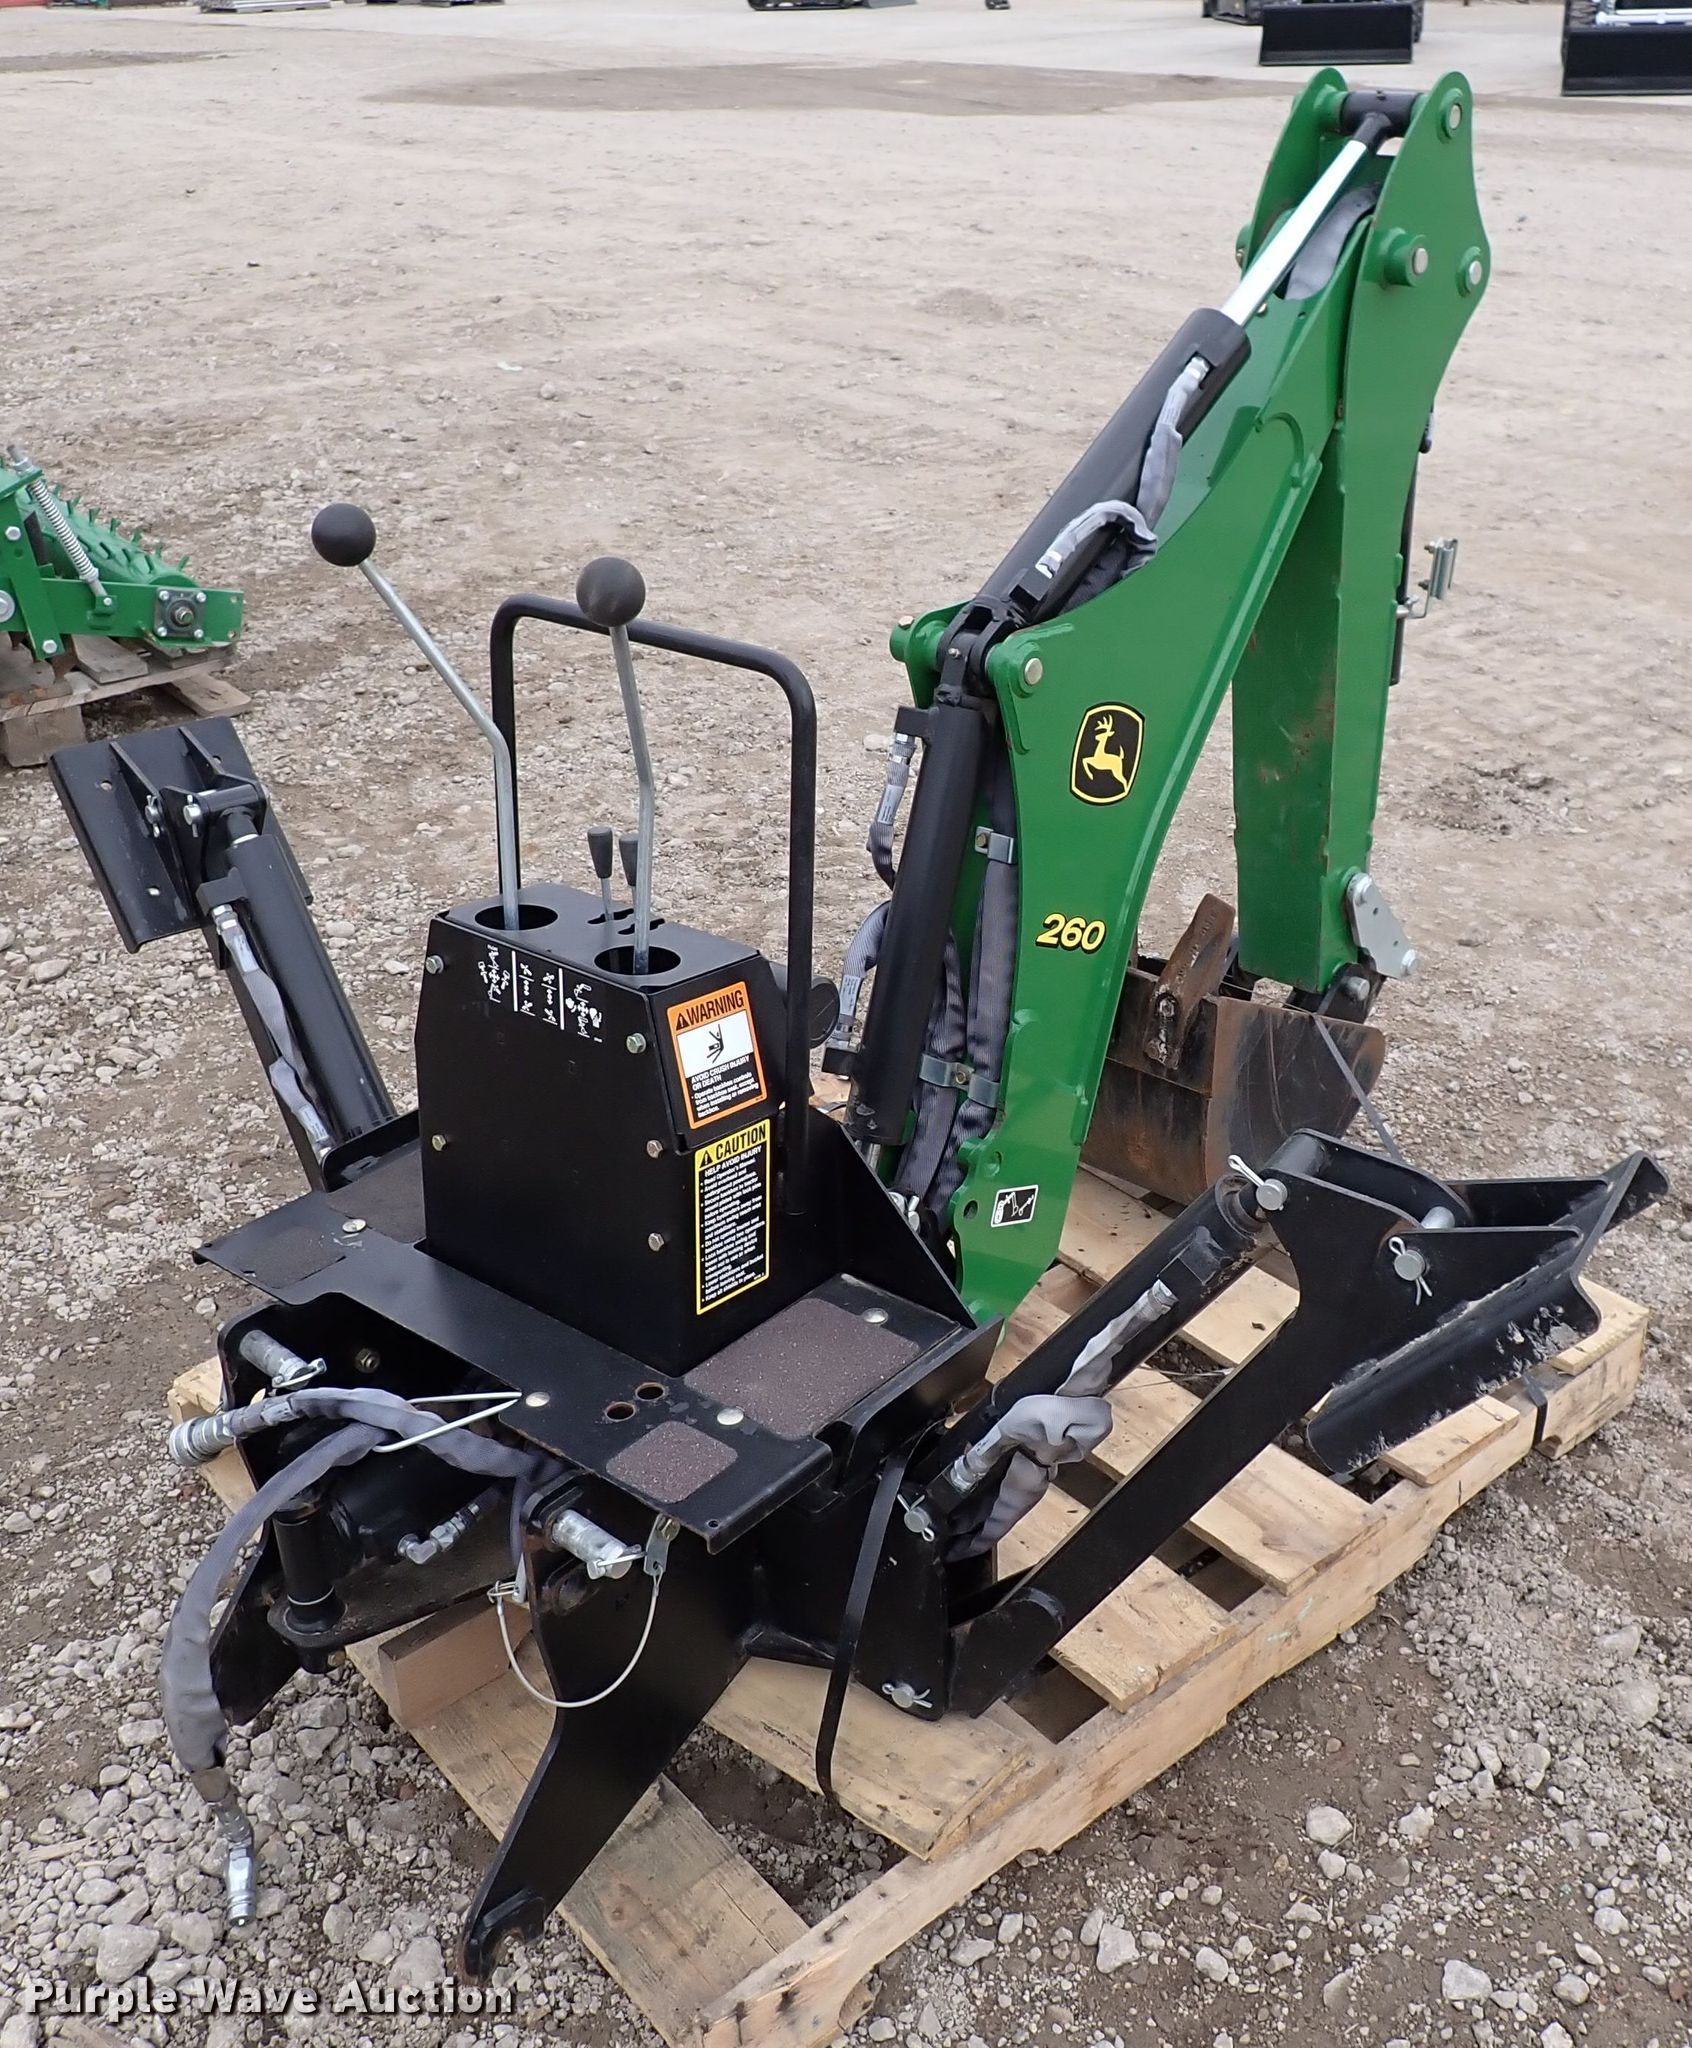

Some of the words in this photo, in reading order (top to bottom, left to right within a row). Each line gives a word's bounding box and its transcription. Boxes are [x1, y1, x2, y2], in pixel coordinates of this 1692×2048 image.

[1036, 913, 1106, 954] 260
[686, 990, 744, 1025] WARNING
[692, 1072, 709, 1083] AVOID
[693, 1083, 702, 1091] OR
[702, 1075, 722, 1087] DEATH
[716, 1123, 766, 1160] CAUTION
[705, 1164, 721, 1177] HELP
[722, 1156, 740, 1169] AVOID
